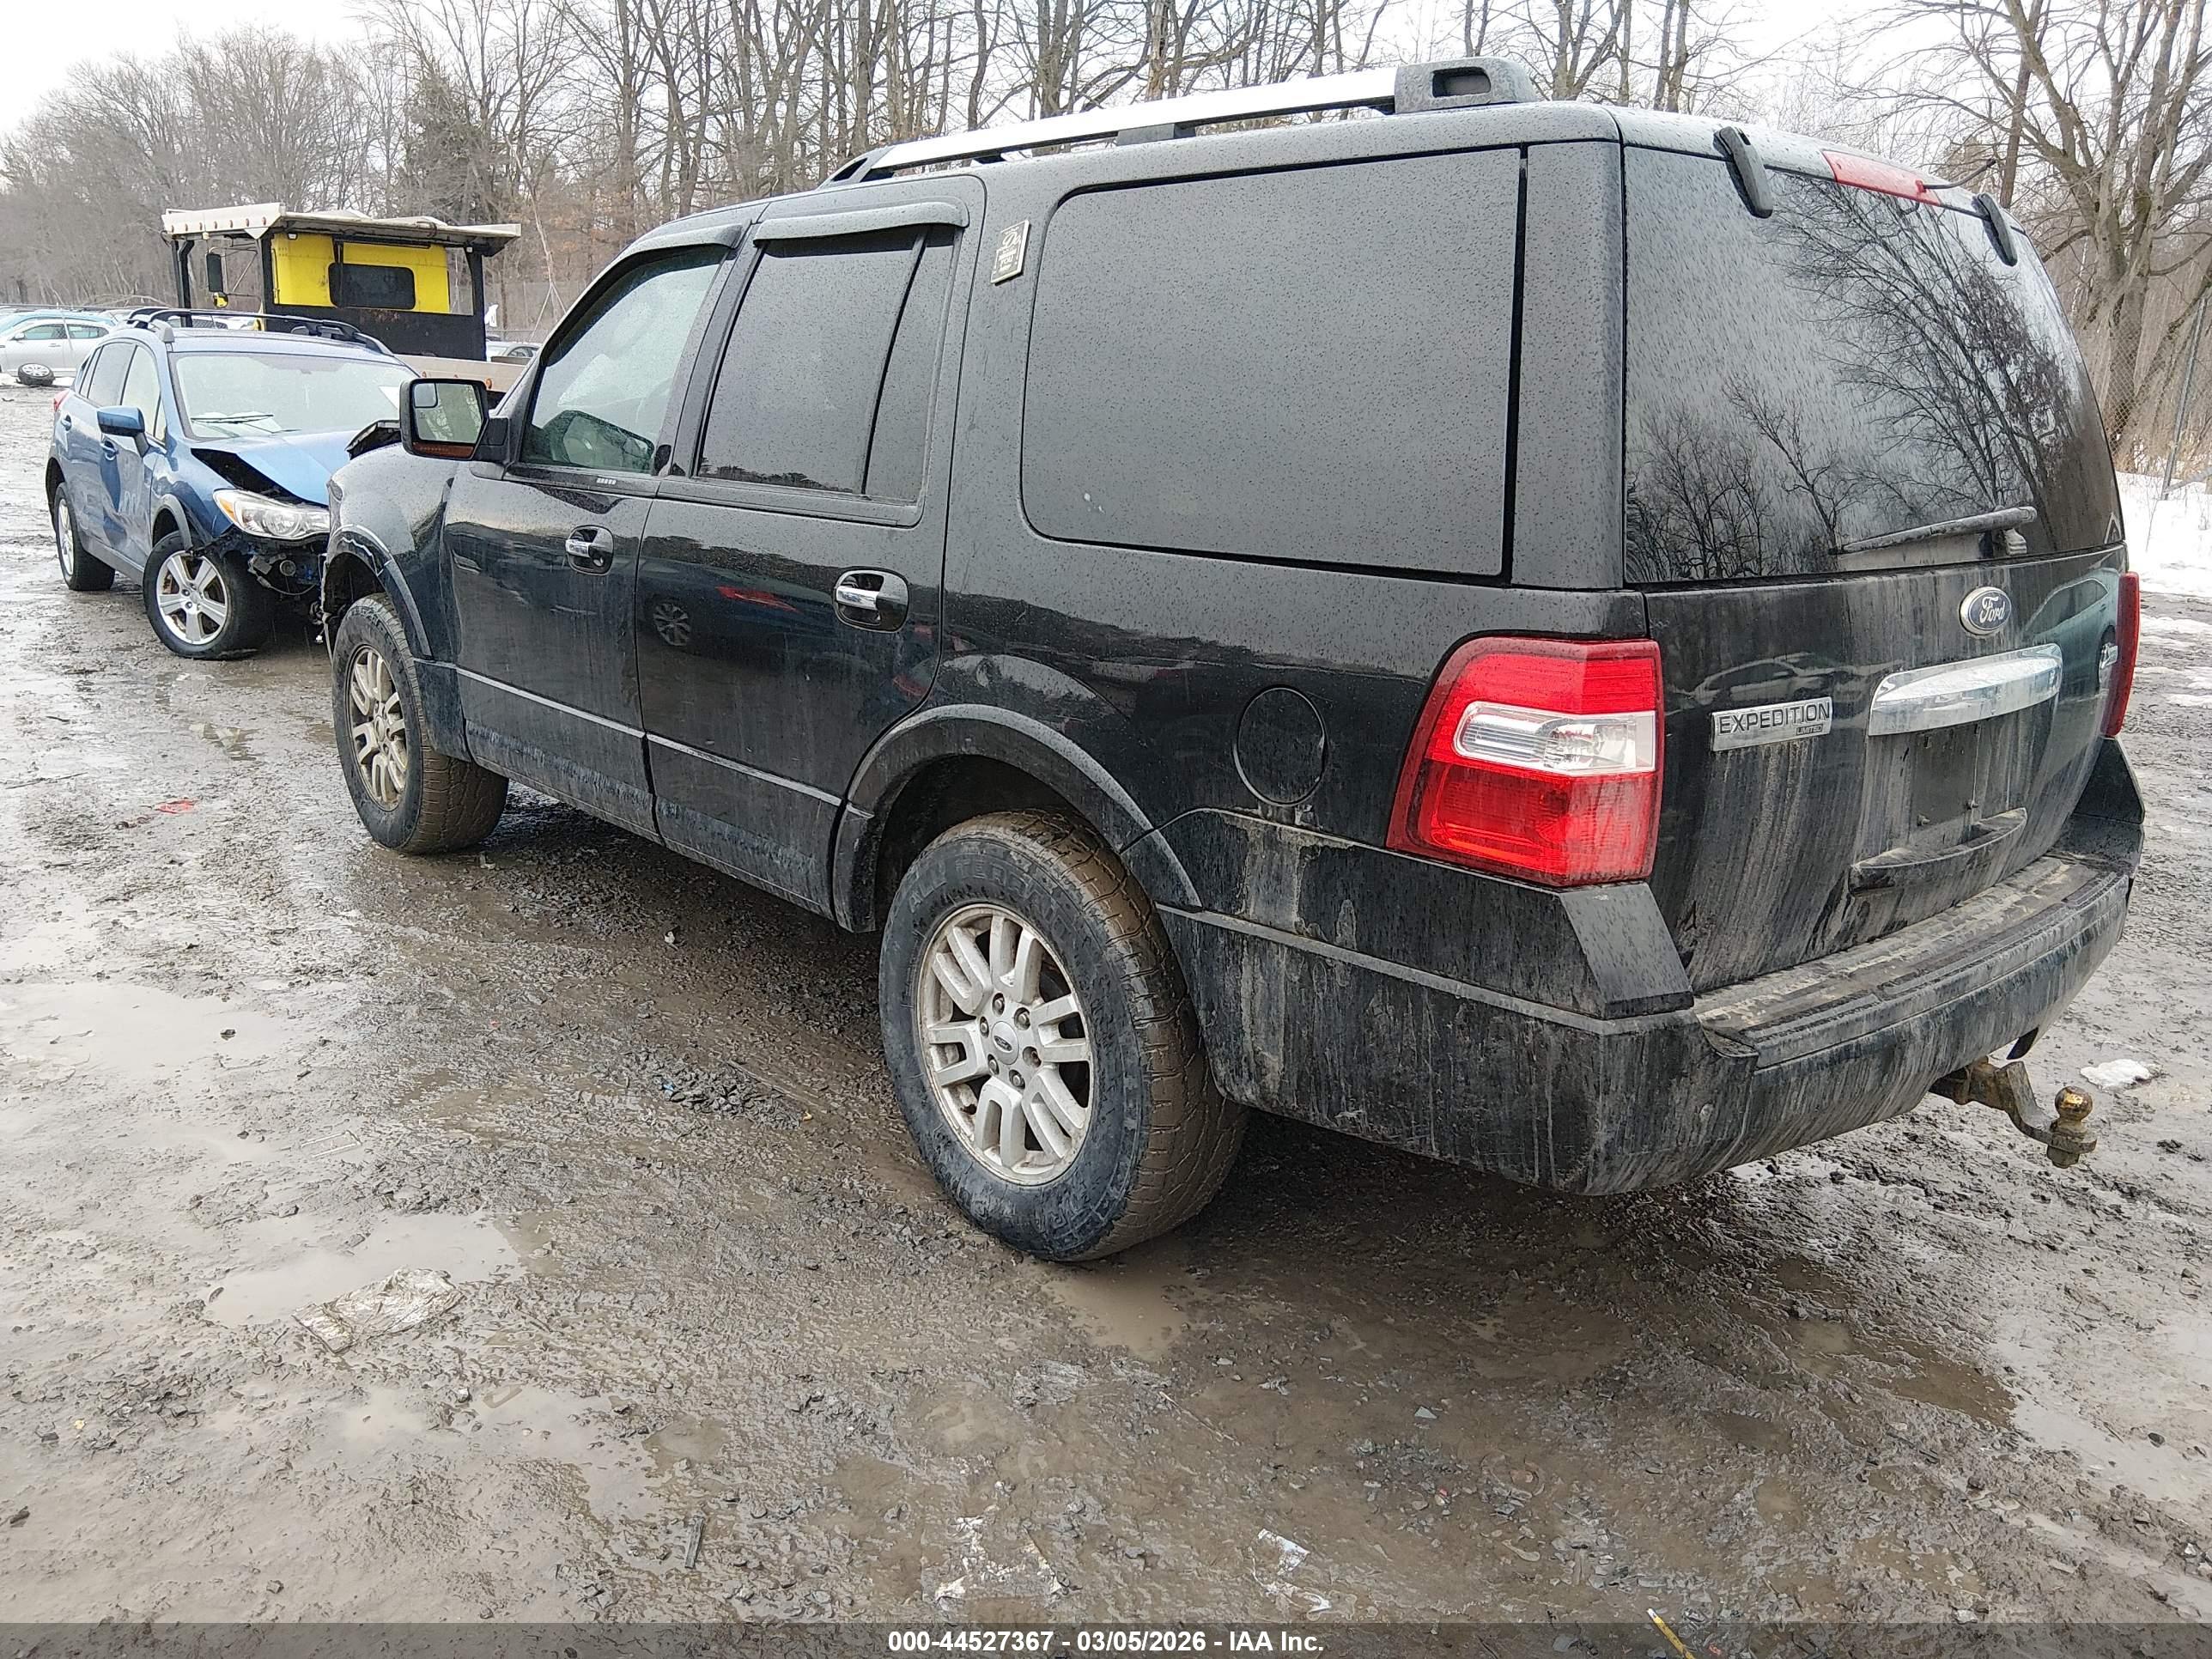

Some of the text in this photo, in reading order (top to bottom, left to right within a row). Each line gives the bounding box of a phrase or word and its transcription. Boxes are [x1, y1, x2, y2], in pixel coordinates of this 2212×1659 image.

[1979, 596, 2006, 623] Ford
[1718, 702, 1830, 735] EXPEDITION
[1796, 724, 1823, 736] LIMITED
